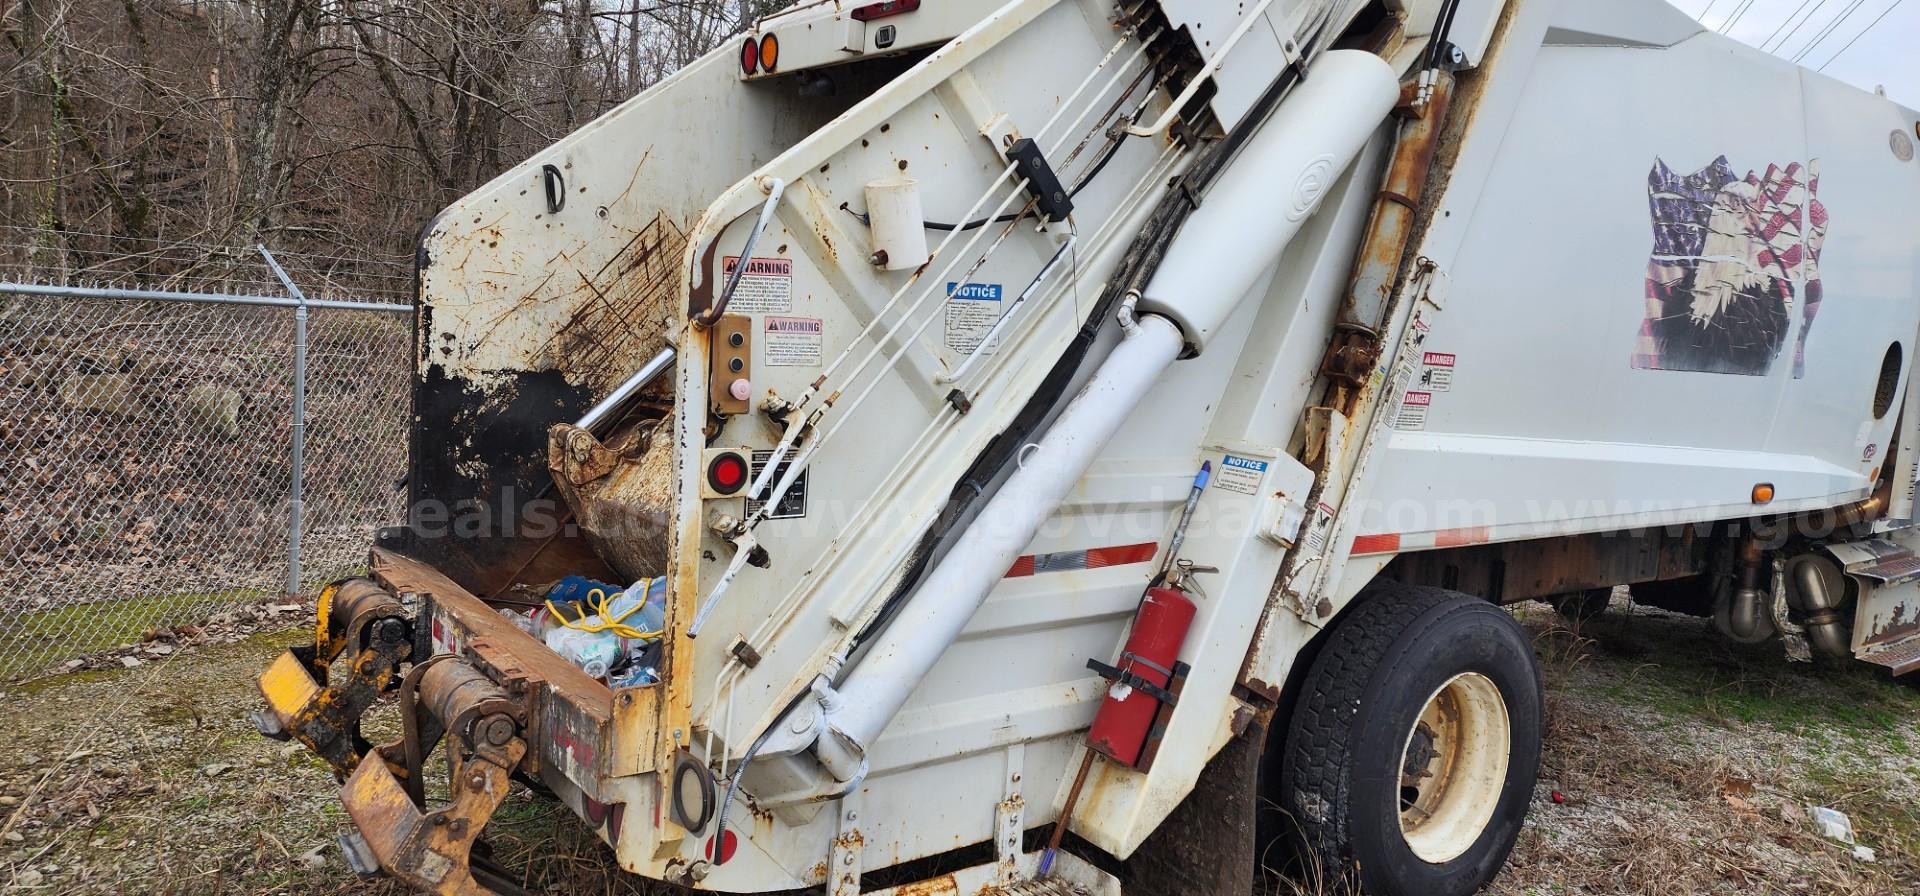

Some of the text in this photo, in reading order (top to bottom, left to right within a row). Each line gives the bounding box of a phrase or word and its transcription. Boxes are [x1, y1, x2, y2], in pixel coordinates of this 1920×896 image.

[779, 321, 819, 332] WARNING
[1430, 354, 1454, 365] DANGER
[1405, 393, 1430, 404] DANGER
[1228, 457, 1262, 470] NOTICE
